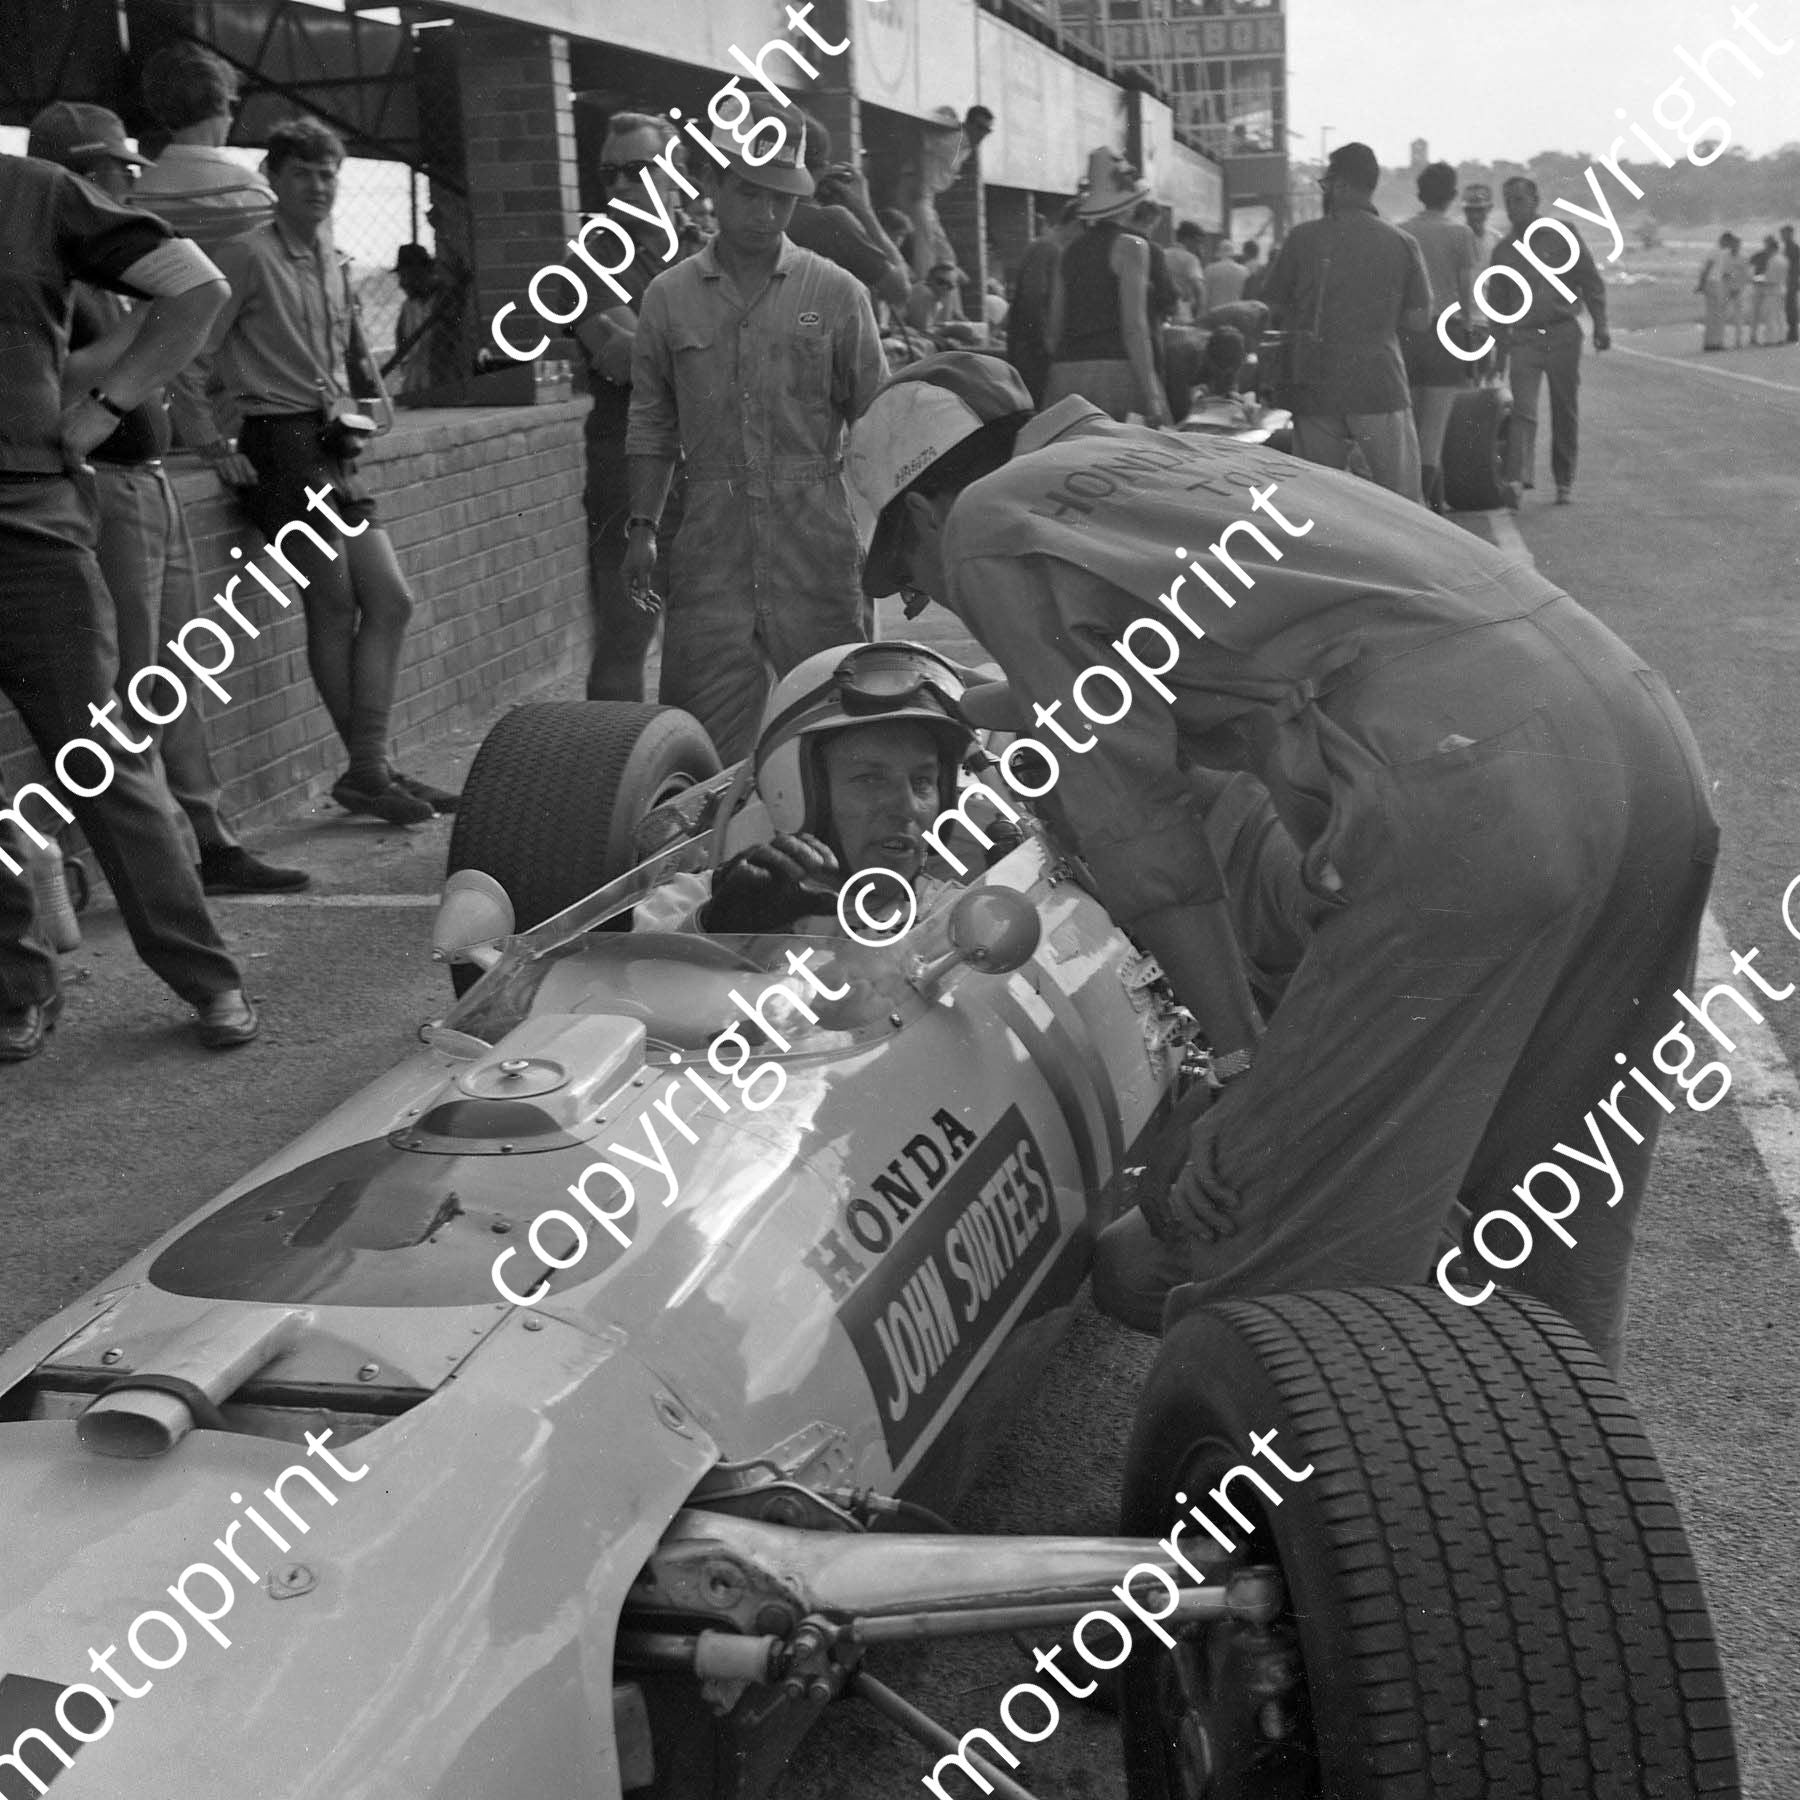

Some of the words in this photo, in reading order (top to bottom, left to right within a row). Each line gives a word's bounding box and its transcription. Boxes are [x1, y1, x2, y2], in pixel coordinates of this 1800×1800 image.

[802, 1107, 977, 1303] HONDA
[874, 1255, 960, 1422] JOHN
[945, 1138, 1049, 1323] SURTEES
